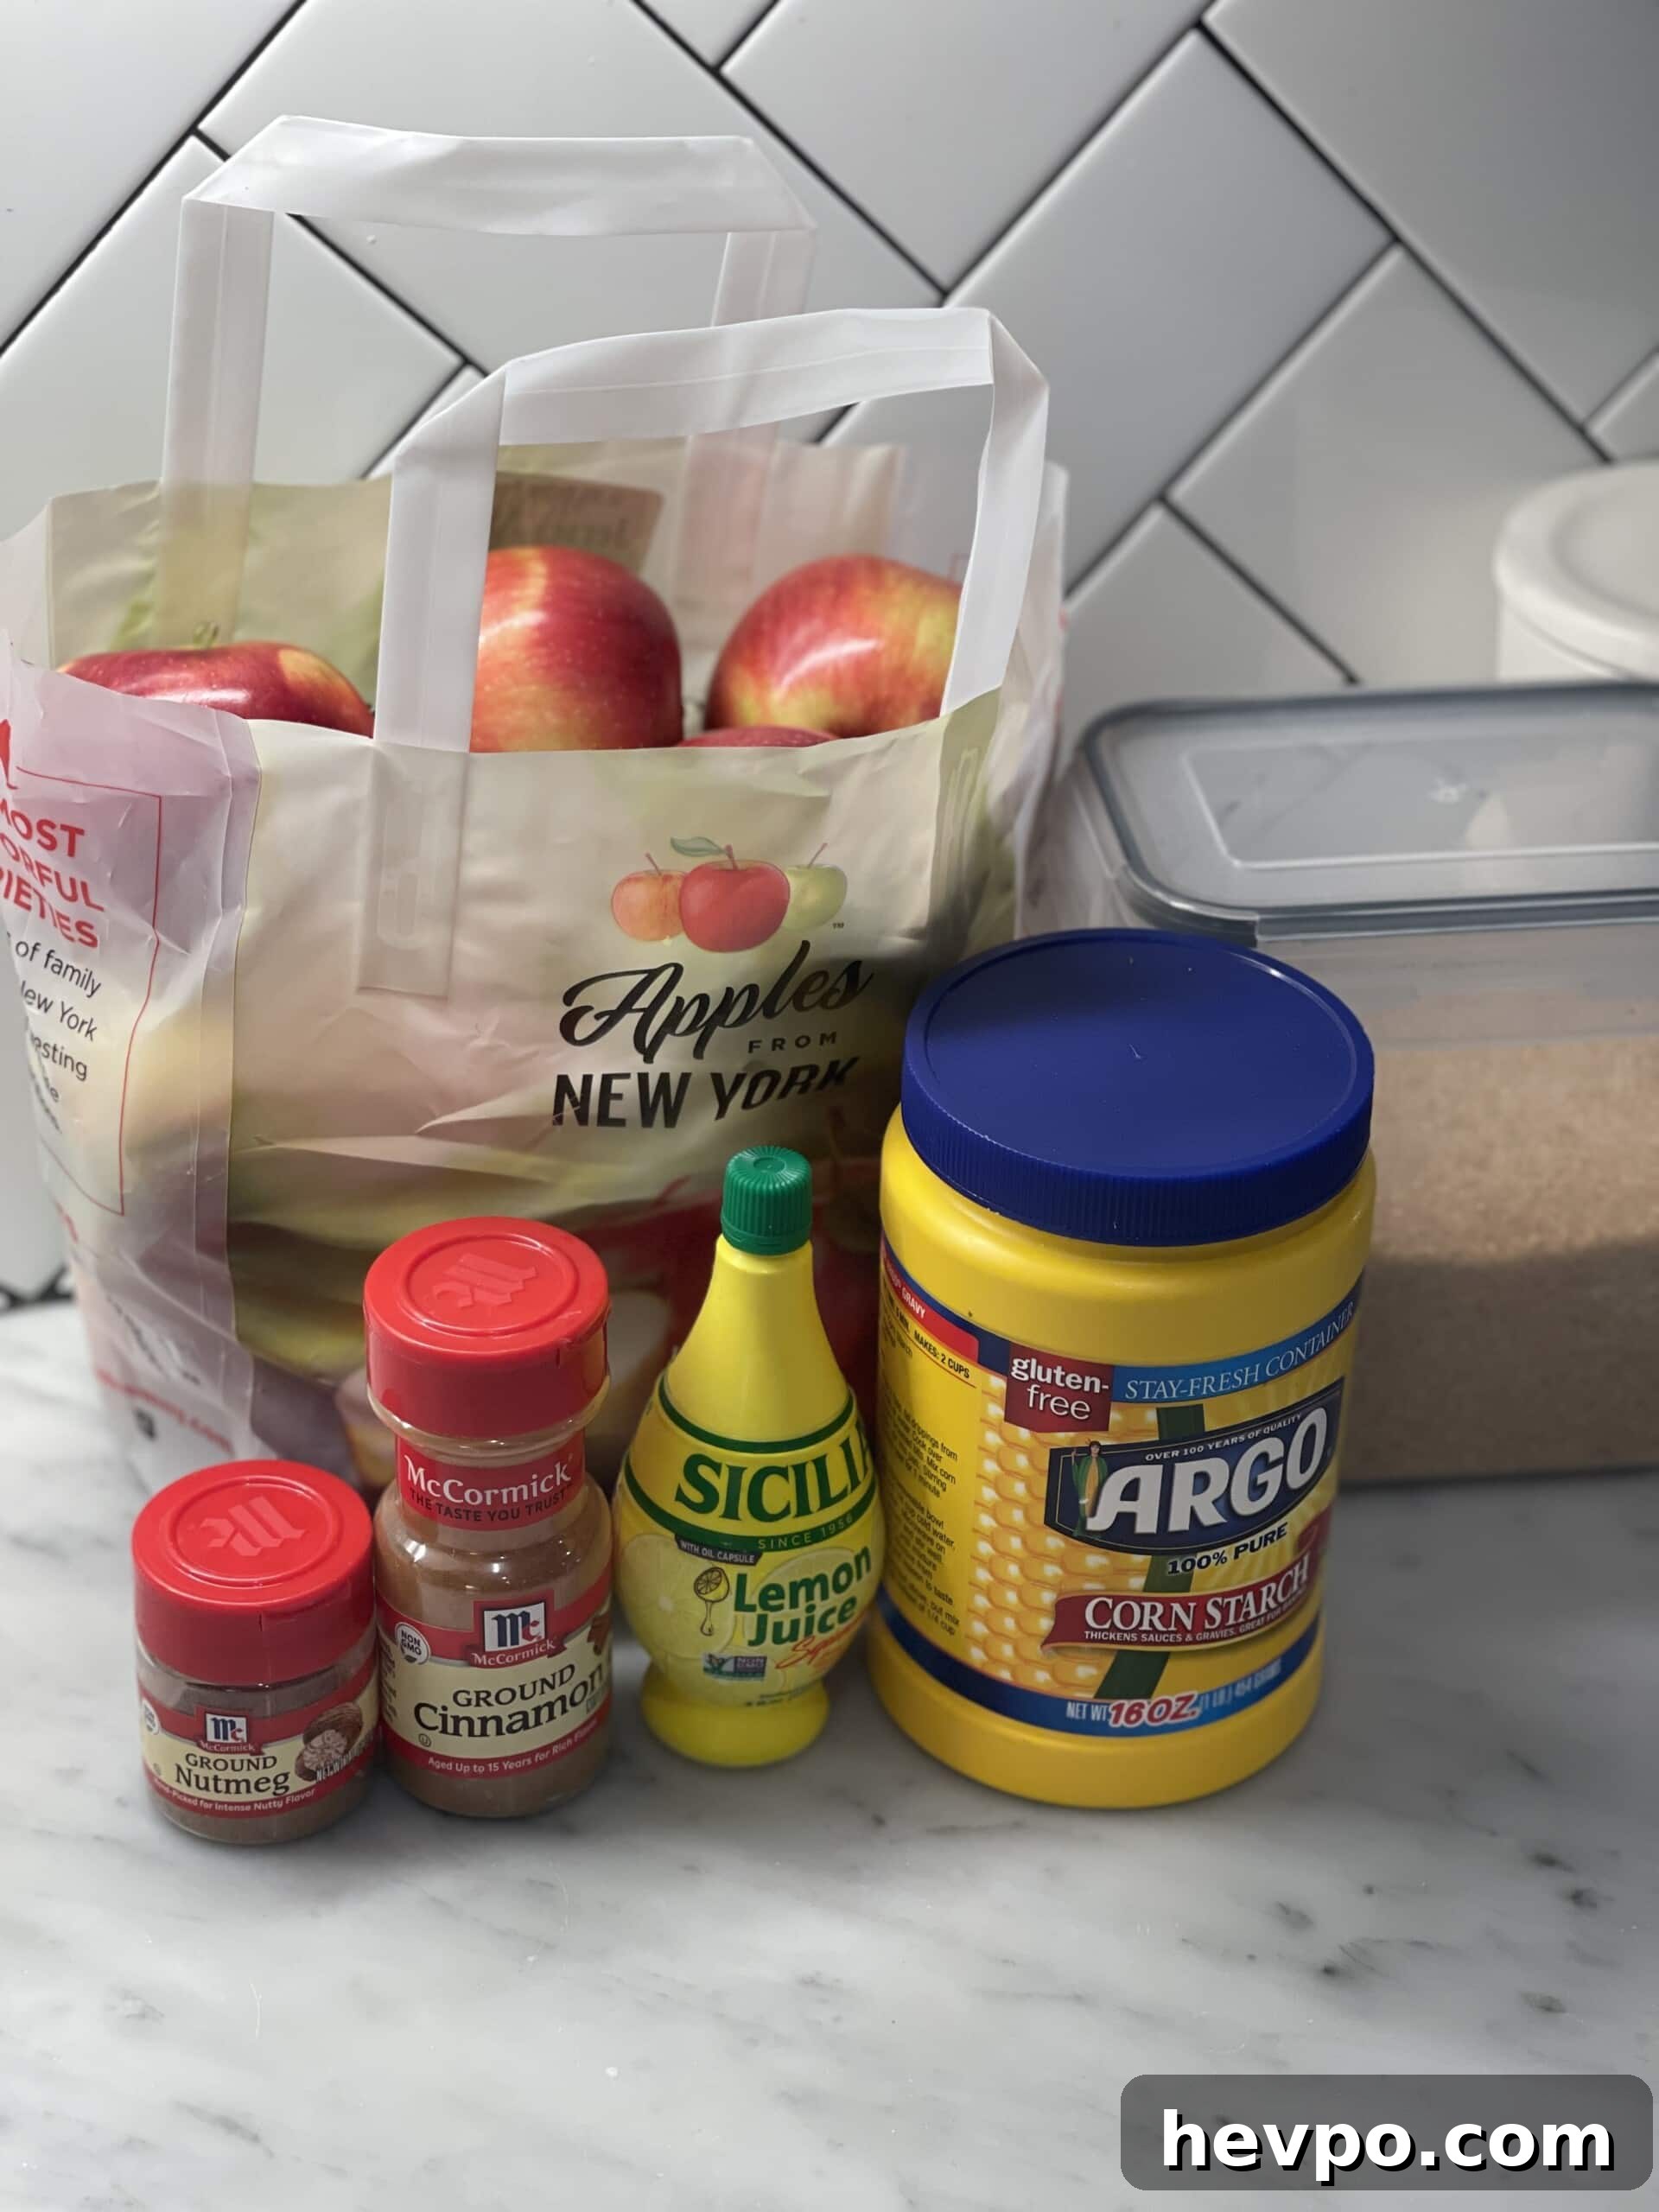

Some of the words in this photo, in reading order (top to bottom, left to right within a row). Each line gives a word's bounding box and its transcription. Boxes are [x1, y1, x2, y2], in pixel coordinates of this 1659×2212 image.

[0, 867, 99, 948] IETIES
[15, 940, 41, 962] of
[43, 949, 102, 999] family
[559, 939, 874, 1065] Apples
[59, 1000, 98, 1042] York
[748, 1032, 837, 1054] FROM
[552, 1071, 691, 1129] NEW
[710, 1056, 861, 1122] YORK
[901, 1287, 926, 1319] GRAVY
[940, 1352, 947, 1364] 2
[947, 1357, 970, 1379] CUPS
[1125, 1365, 1259, 1400] STAY-FRESH
[1265, 1300, 1355, 1377] CONTAINER
[1010, 1357, 1109, 1394] gluten-
[1027, 1384, 1091, 1421] free
[1145, 1449, 1180, 1462] OVER
[1182, 1445, 1205, 1457] 100
[1207, 1434, 1246, 1452] YEARS
[1246, 1428, 1263, 1440] OF
[1262, 1412, 1302, 1435] QUALITY
[404, 1454, 572, 1506] McCormick
[1085, 1407, 1328, 1535] ARGO
[409, 1488, 432, 1510] THE
[434, 1502, 482, 1522] TASTE
[486, 1506, 521, 1522] YOU
[679, 1539, 700, 1555] WITH
[700, 1547, 715, 1559] OIL
[716, 1550, 756, 1565] CAPSULE
[757, 1533, 812, 1551] SINCE
[1167, 1550, 1228, 1576] 100%
[1233, 1522, 1288, 1561] PURE
[734, 1545, 872, 1613] Lemon
[1084, 1597, 1198, 1632] CORN
[1204, 1554, 1312, 1630] STARCH
[400, 1629, 422, 1647] NON
[747, 1596, 858, 1648] Juice
[1084, 1630, 1139, 1643] THICKENS
[1140, 1631, 1184, 1643] SAUCES
[471, 1638, 556, 1666] McCormick
[414, 1662, 604, 1738] Cinnamon
[452, 1663, 576, 1708] GROUND
[1065, 1700, 1088, 1720] NET
[175, 1762, 291, 1796] Nutmeg
[185, 1752, 278, 1773] GROUND
[428, 1756, 453, 1770] Aged
[454, 1764, 471, 1774] Up
[473, 1764, 485, 1773] to
[488, 1763, 500, 1772] 15
[501, 1757, 532, 1770] Years
[534, 1750, 550, 1764] for
[200, 1800, 213, 1809] for
[214, 1802, 251, 1812] Intense
[253, 1799, 283, 1811] Nutty
[285, 1788, 316, 1803] Flavor
